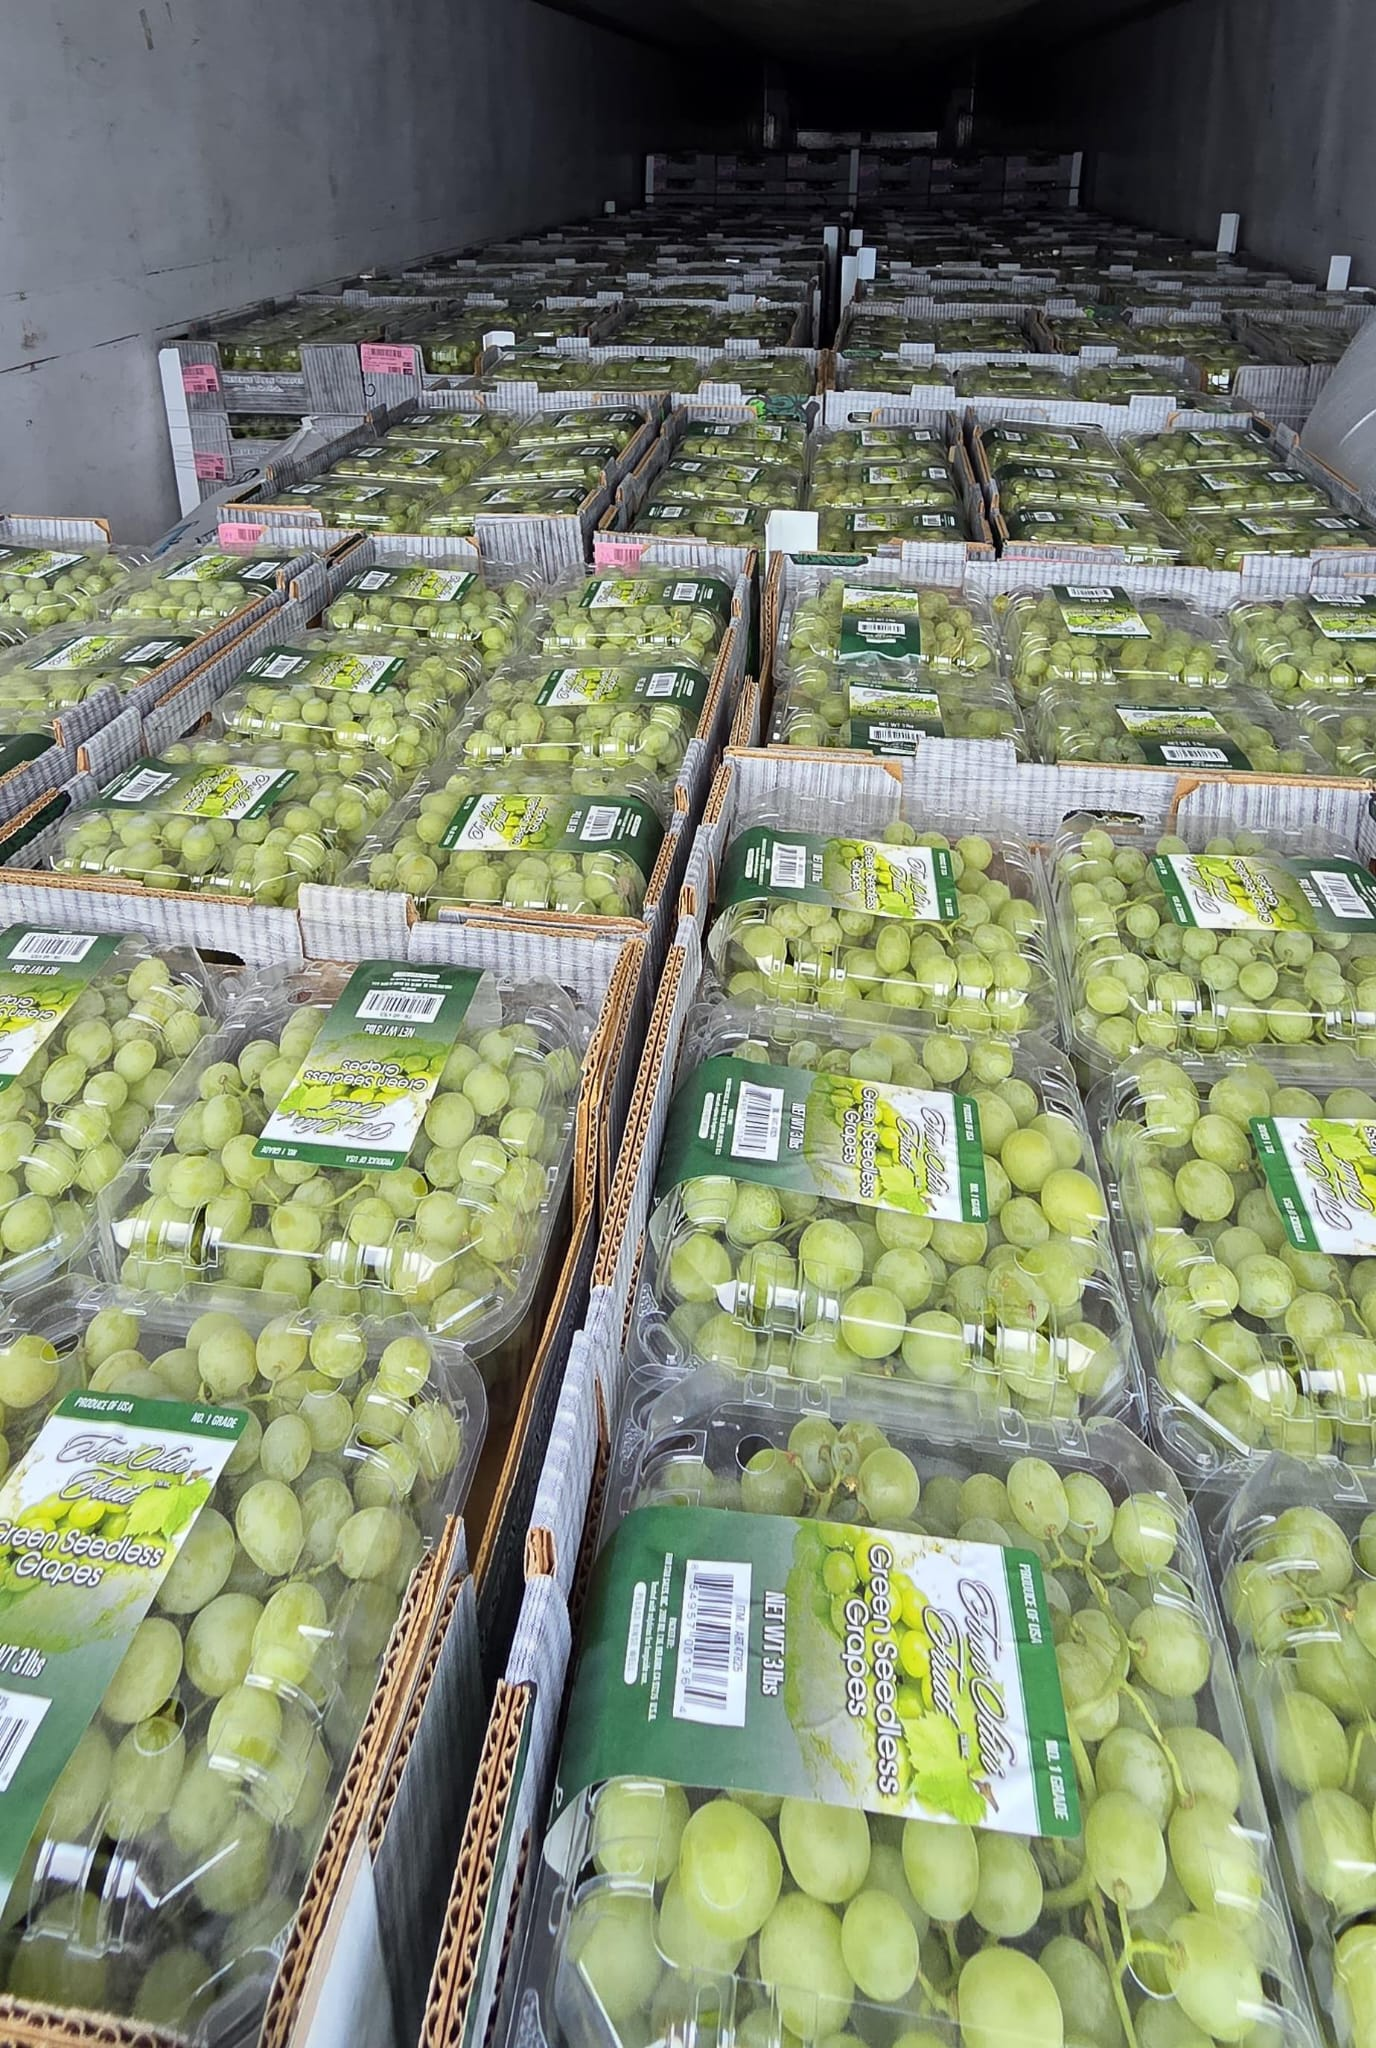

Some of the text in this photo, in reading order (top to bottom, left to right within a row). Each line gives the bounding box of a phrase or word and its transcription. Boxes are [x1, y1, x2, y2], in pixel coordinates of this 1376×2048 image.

[0, 994, 34, 1008] Grap
[9, 1007, 56, 1022] Green
[303, 1069, 429, 1092] Green Seedless
[340, 1059, 400, 1078] Grapes
[841, 1110, 860, 1164] Grapes
[860, 1087, 879, 1198] Green Seedless
[74, 1397, 134, 1414] PRODUCE OF USA
[191, 1412, 204, 1424] NO.
[212, 1415, 238, 1430] GRADE
[60, 1528, 165, 1568] Seedless
[15, 1551, 104, 1588] Grapes
[687, 1584, 698, 1630] 54957
[764, 1590, 787, 1623] NET
[1019, 1563, 1042, 1644] PRODUCE OF USA
[762, 1624, 786, 1658] WT
[840, 1599, 870, 1718] Grapes
[680, 1639, 694, 1686] 00136
[869, 1545, 902, 1796] Green Seedless
[1050, 1776, 1069, 1822] GRADE
